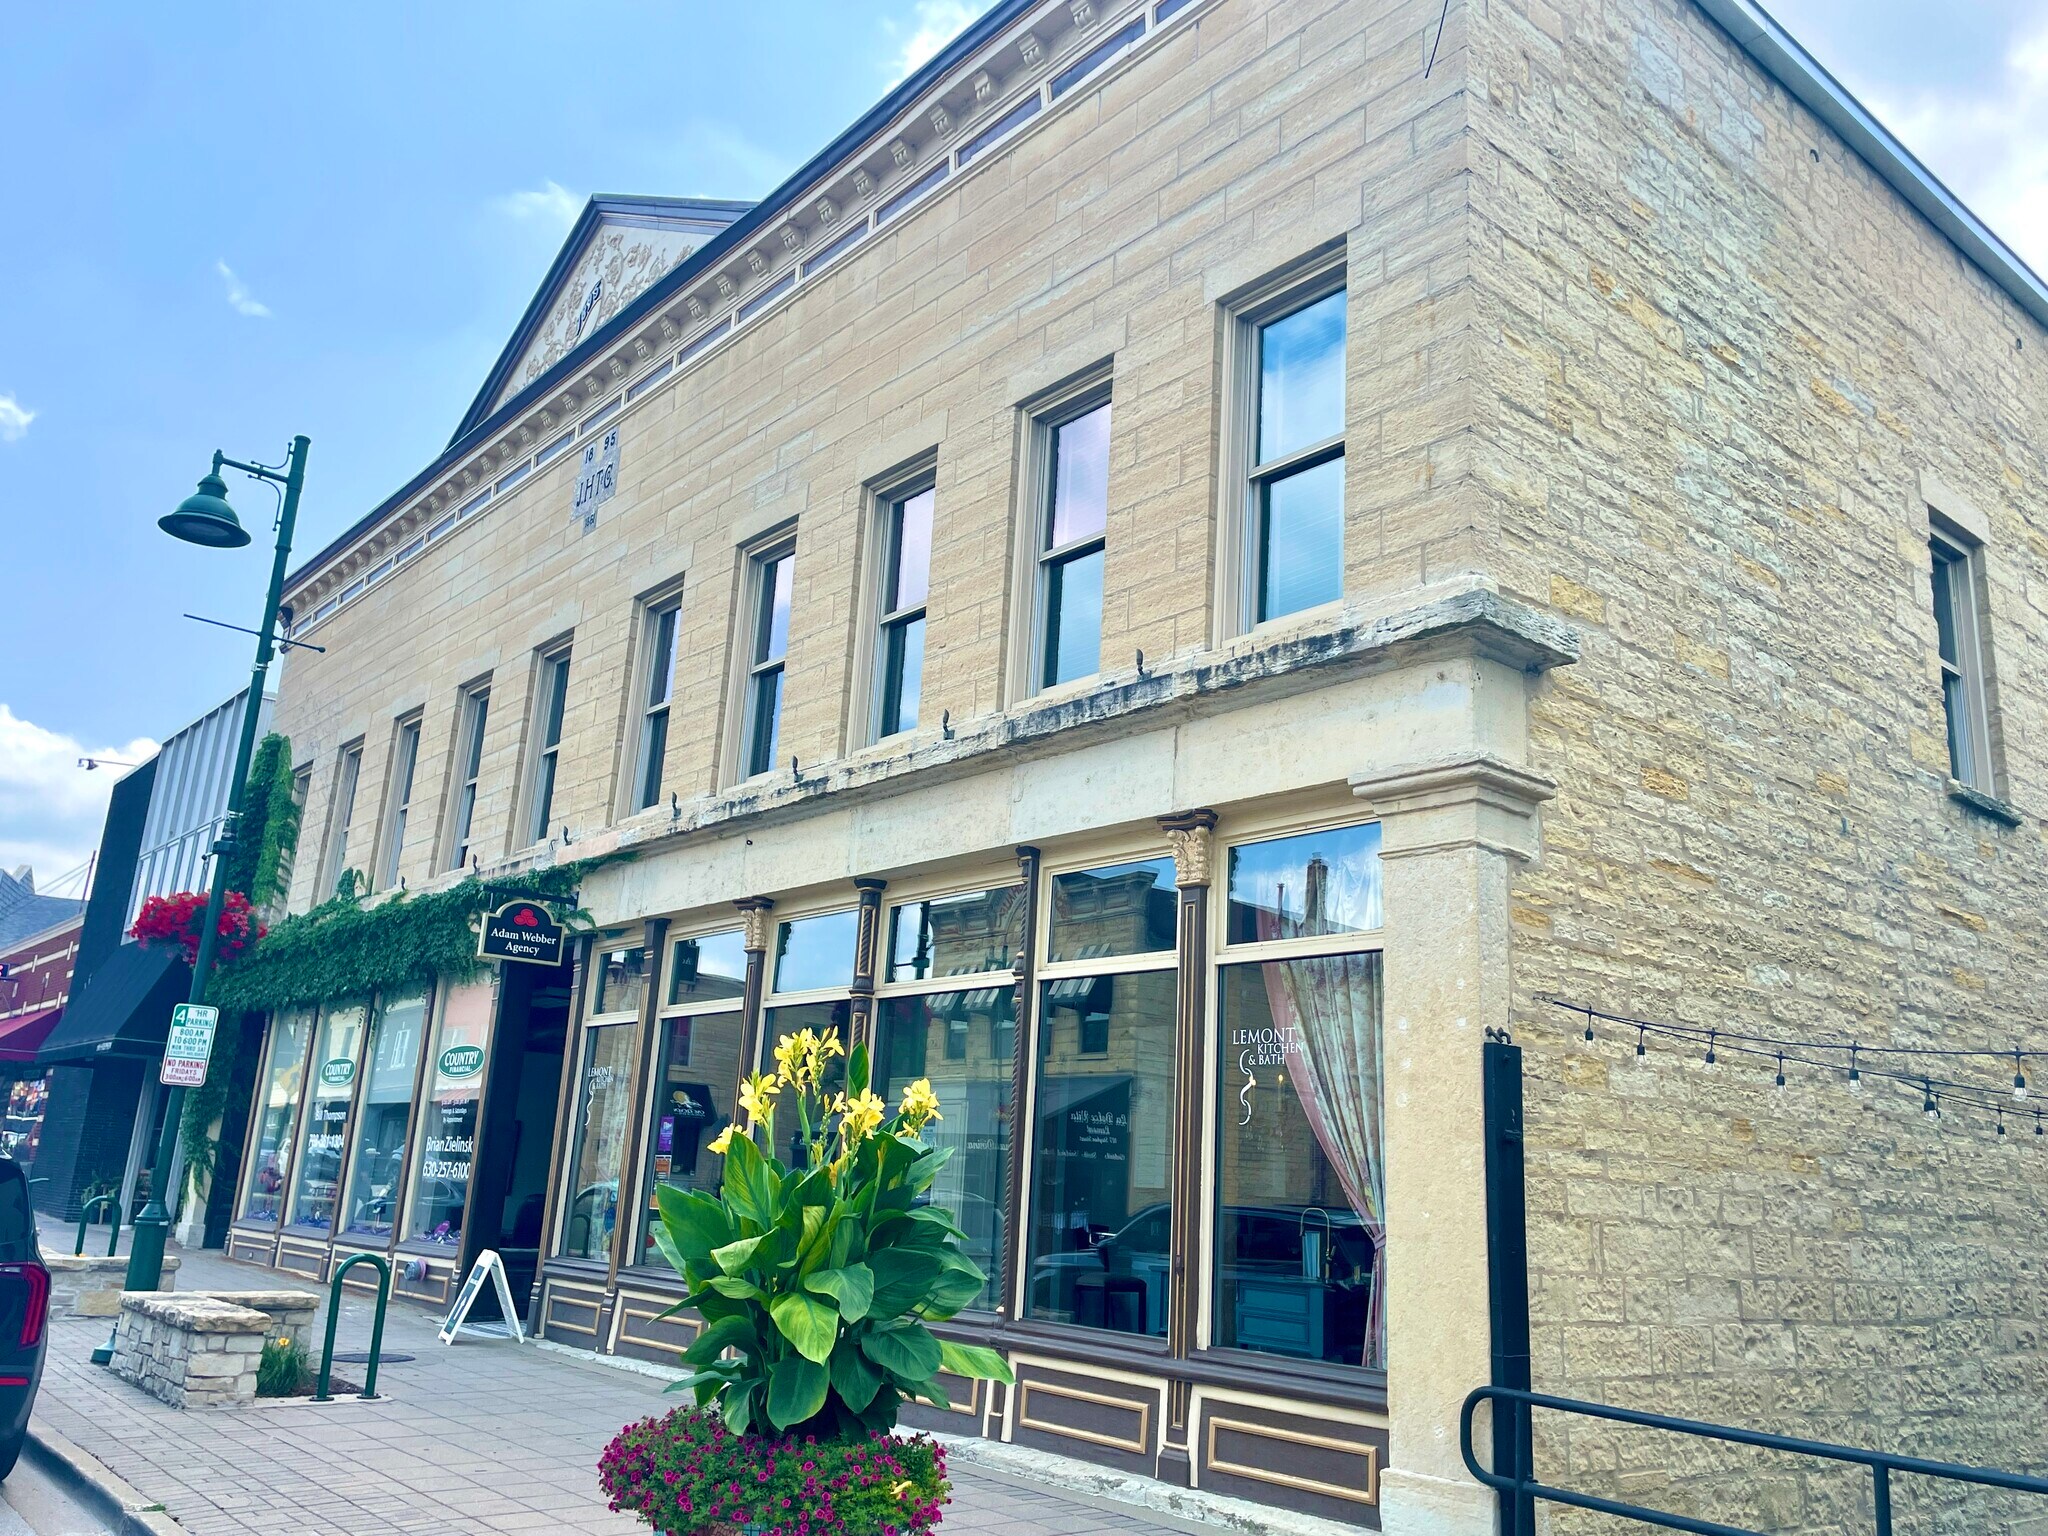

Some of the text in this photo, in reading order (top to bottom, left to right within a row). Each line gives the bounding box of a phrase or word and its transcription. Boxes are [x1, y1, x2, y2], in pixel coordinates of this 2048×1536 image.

[585, 431, 616, 464] 18 95
[491, 928, 557, 945] Adam Webber
[505, 941, 540, 956] Agency
[176, 1009, 208, 1024] 4 HR
[187, 1018, 213, 1027] PARKING
[1232, 1027, 1296, 1045] LEMONT
[1257, 1042, 1304, 1054] KITCHEN
[178, 1060, 204, 1069] PARKING
[444, 1050, 480, 1066] COUNTRY
[1248, 1054, 1285, 1065] & BATH
[171, 1068, 197, 1076] FRIDAYS
[325, 1063, 352, 1076] COUNTRY
[588, 1066, 612, 1077] LEMONT
[323, 1109, 347, 1123] Thompson
[426, 1135, 473, 1153] Brian Zielinsk
[423, 1161, 471, 1179] 630-257-6100
